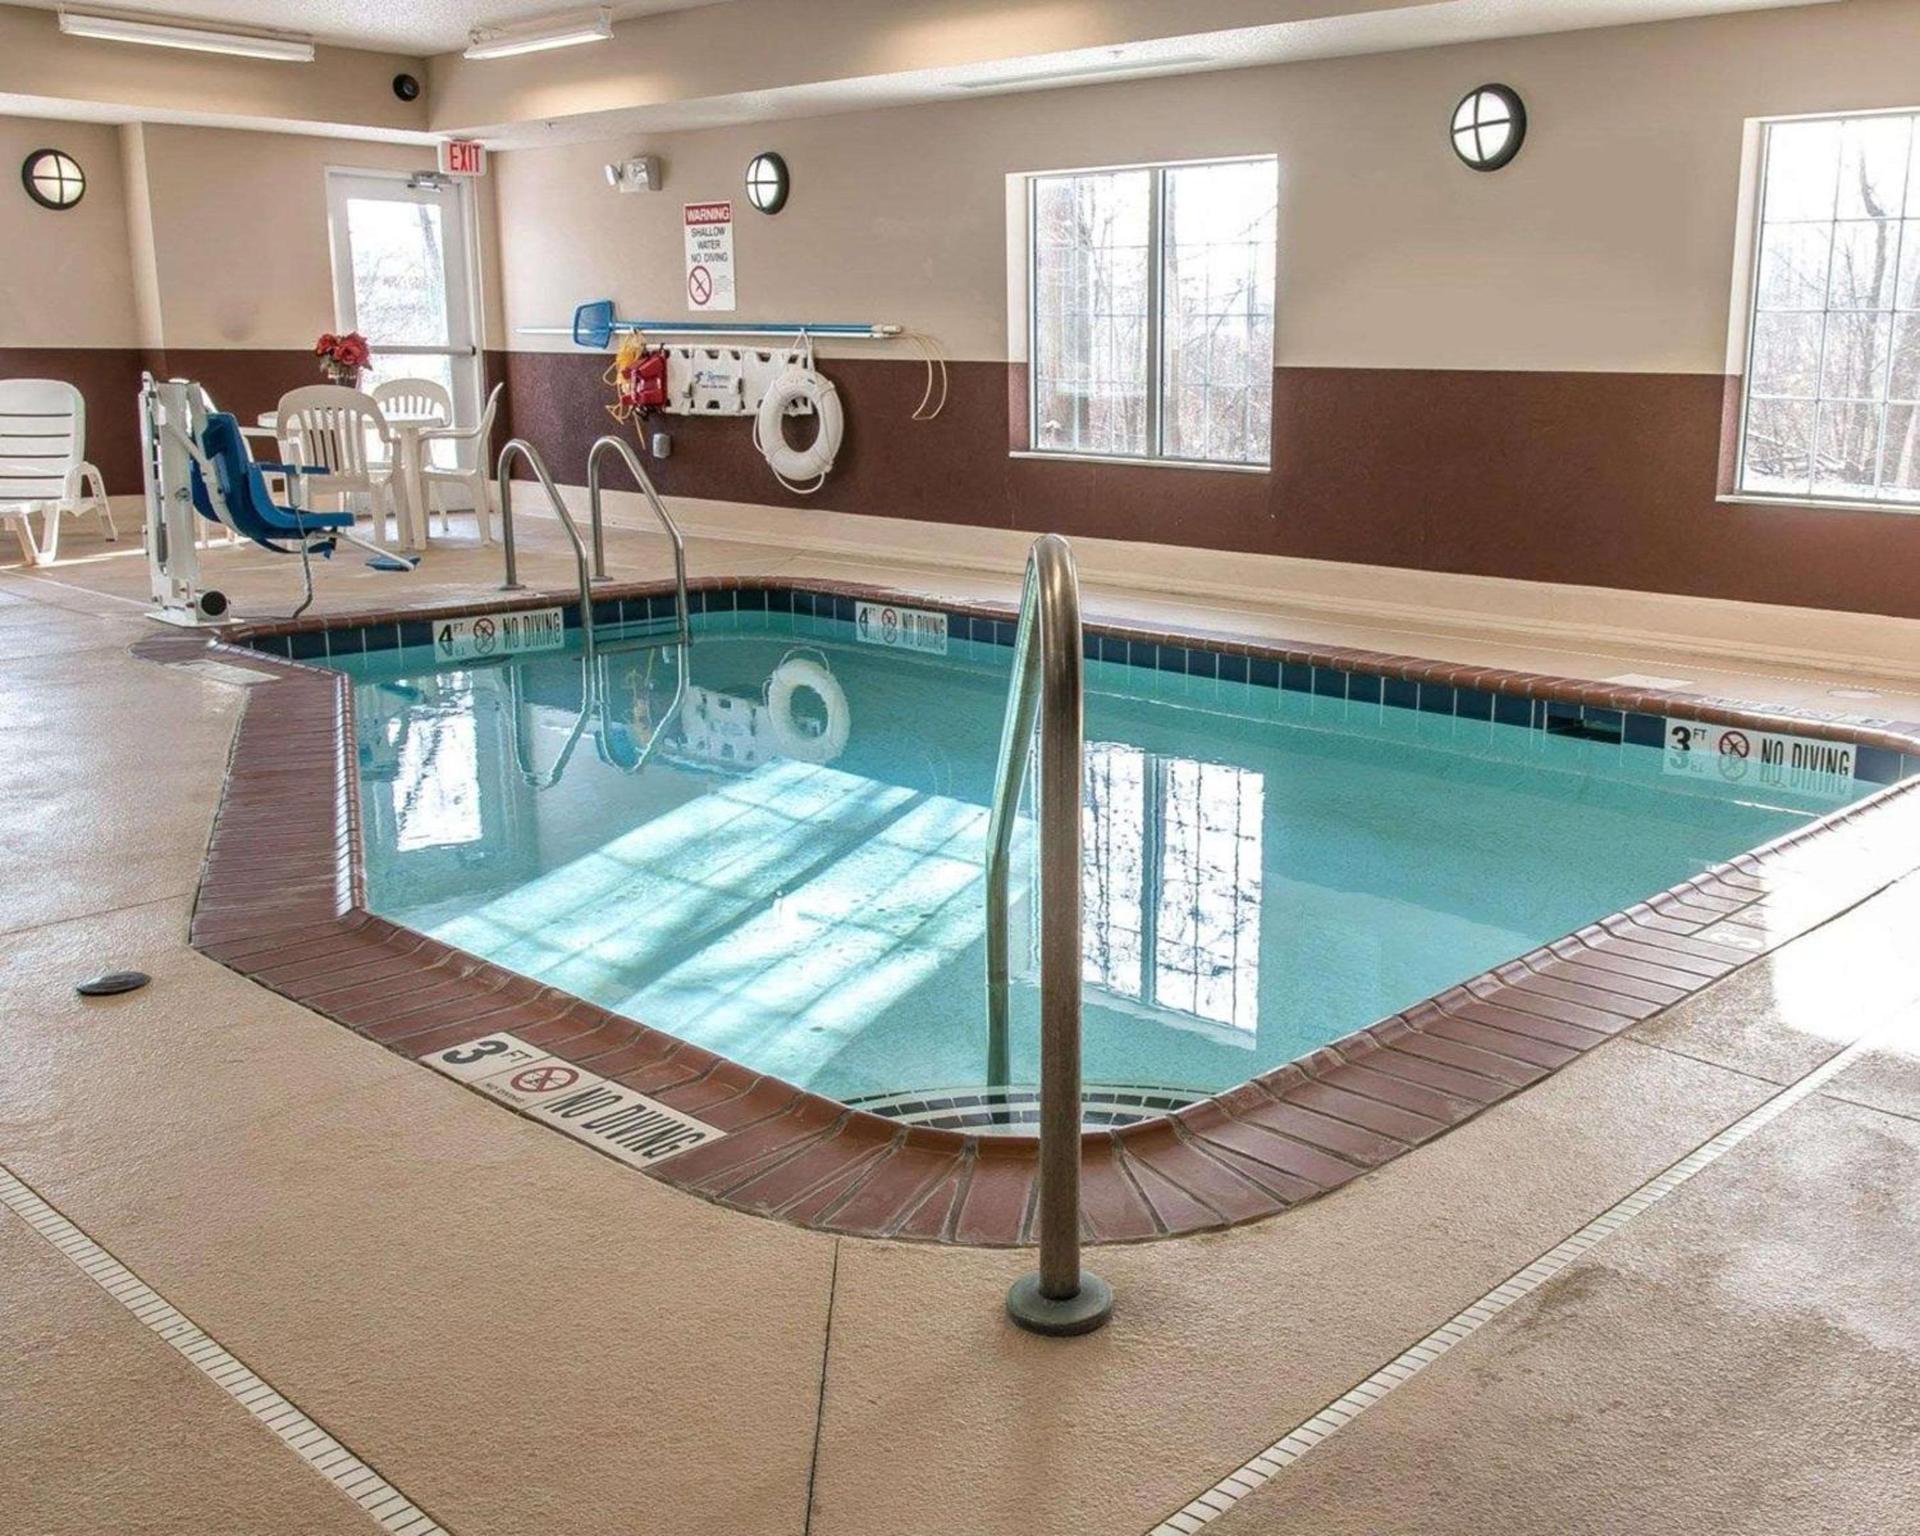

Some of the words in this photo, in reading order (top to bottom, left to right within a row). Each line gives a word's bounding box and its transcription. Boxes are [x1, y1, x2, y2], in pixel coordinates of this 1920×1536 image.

[450, 143, 481, 172] EXIT
[687, 205, 730, 222] WARNING
[691, 227, 726, 238] SHALLOW
[697, 240, 721, 250] WATER
[691, 253, 702, 263] NO
[704, 252, 728, 263] DIVING
[859, 607, 868, 624] 4
[438, 624, 453, 642] 4
[453, 623, 463, 632] FT
[523, 612, 560, 634] DIVING
[1671, 726, 1691, 751] 3
[1692, 728, 1707, 740] FT
[1761, 738, 1784, 766] NO
[1791, 742, 1850, 776] DIVING
[441, 1040, 509, 1064] 3
[499, 1049, 533, 1063] FT
[543, 1087, 624, 1118] NO
[580, 1103, 706, 1159] DIVING
